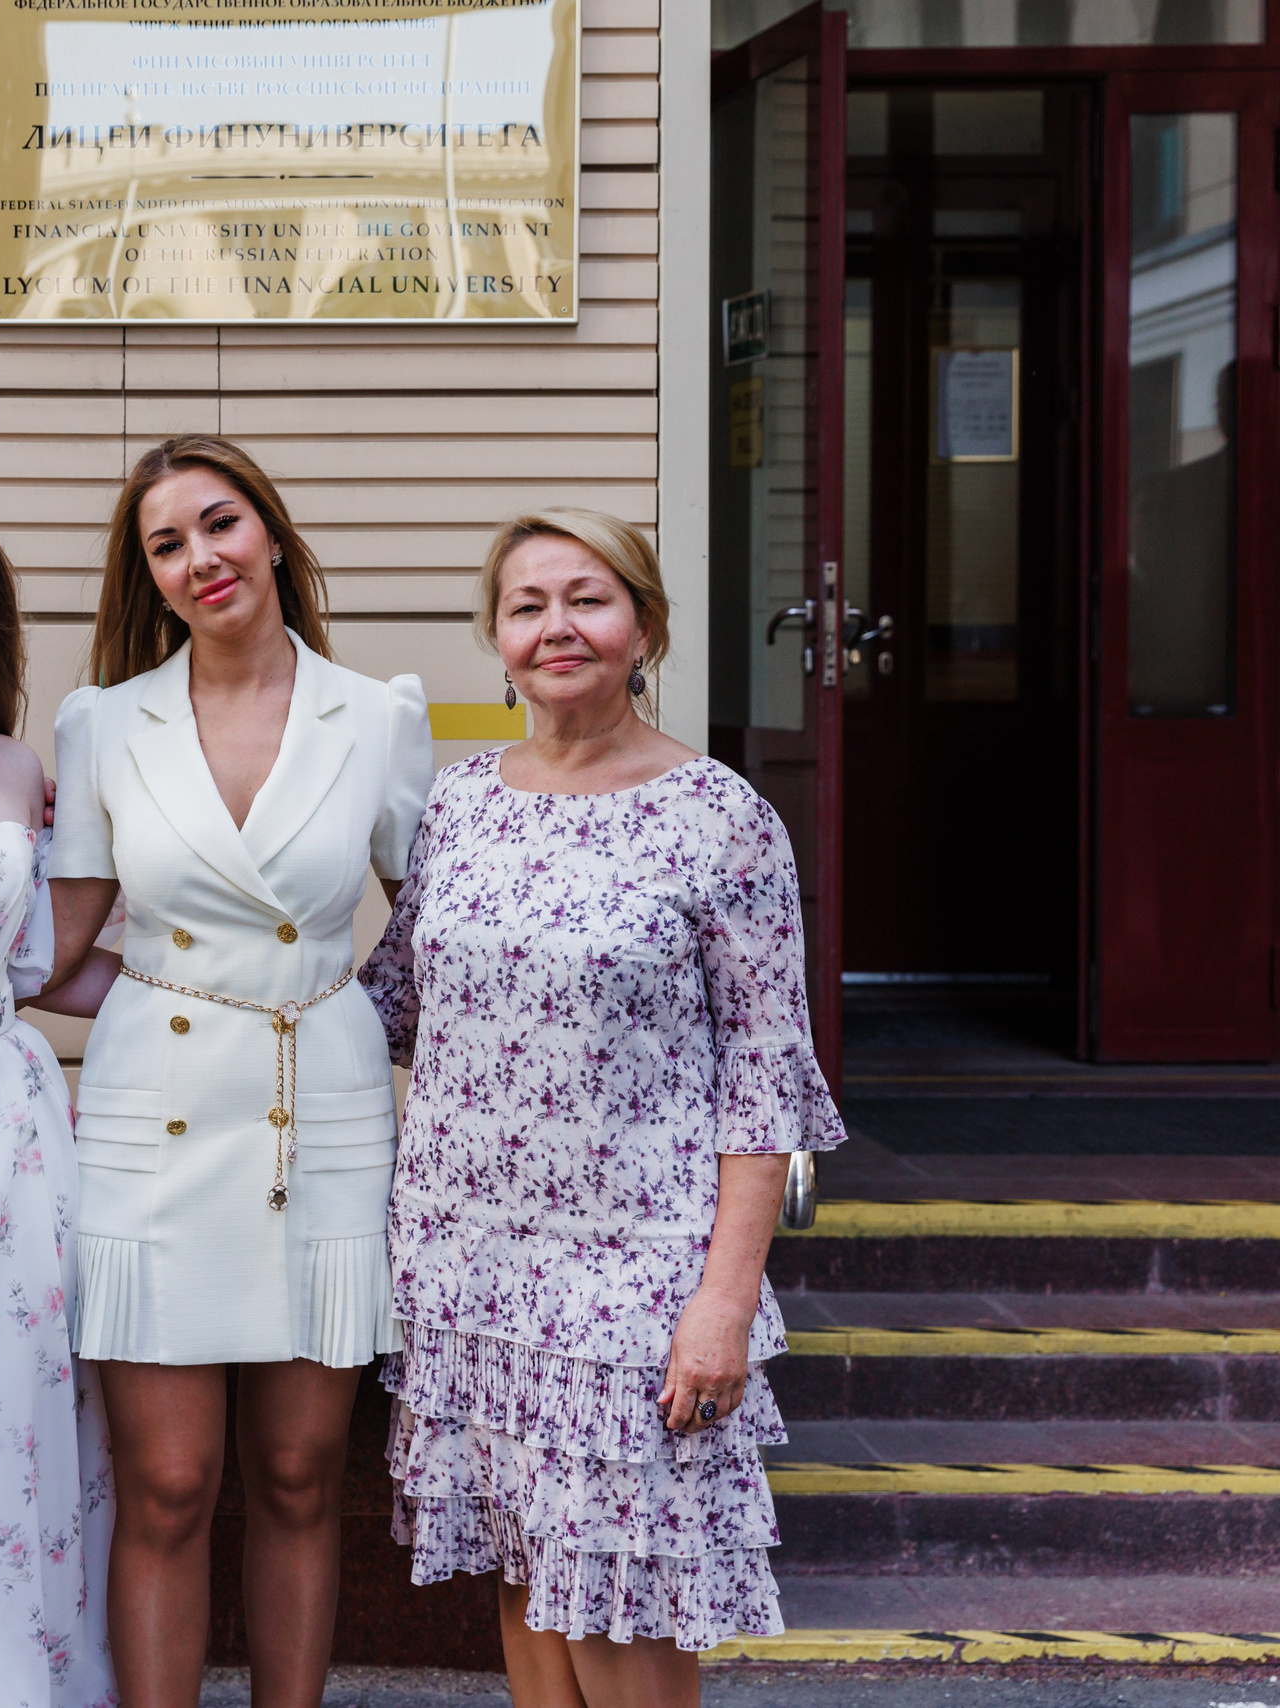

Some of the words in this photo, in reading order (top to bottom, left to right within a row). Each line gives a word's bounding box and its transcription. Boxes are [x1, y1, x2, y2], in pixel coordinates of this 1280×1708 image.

[14, 0, 129, 11] ФЕДЕРАЛЬНОЕ
[132, 0, 286, 10] ГОСУДАРСТВЕННОЕ
[132, 51, 283, 69] ФИНАНСОВЫЙ
[290, 53, 432, 68] УНИВЕРСИТЕТ
[34, 82, 75, 97] ПРИ
[81, 81, 250, 97] ПРАВИТЕЛЬСТВЕ
[256, 77, 397, 96] РОССИЙСКОЙ
[22, 119, 153, 154] ЛИЦЕЙ
[164, 123, 543, 149] ФИНУНИВЕРСИТЕТА
[0, 199, 64, 210] FEDERAL
[479, 197, 565, 208] EDUCATION
[13, 224, 130, 238] FINANCIAL
[137, 223, 266, 238] UNIVERSITY
[274, 223, 345, 238] UNDER
[355, 223, 393, 237] THE
[125, 247, 150, 262] OF
[158, 247, 198, 262] THE
[205, 247, 297, 262] RUSSIAN
[305, 247, 439, 261] FEDERATION
[3, 276, 113, 294] LYCEUM
[122, 276, 154, 294] OF
[165, 276, 217, 294] THE
[228, 275, 382, 294] FINANCIAL
[392, 275, 563, 294] UNIVERSITY
